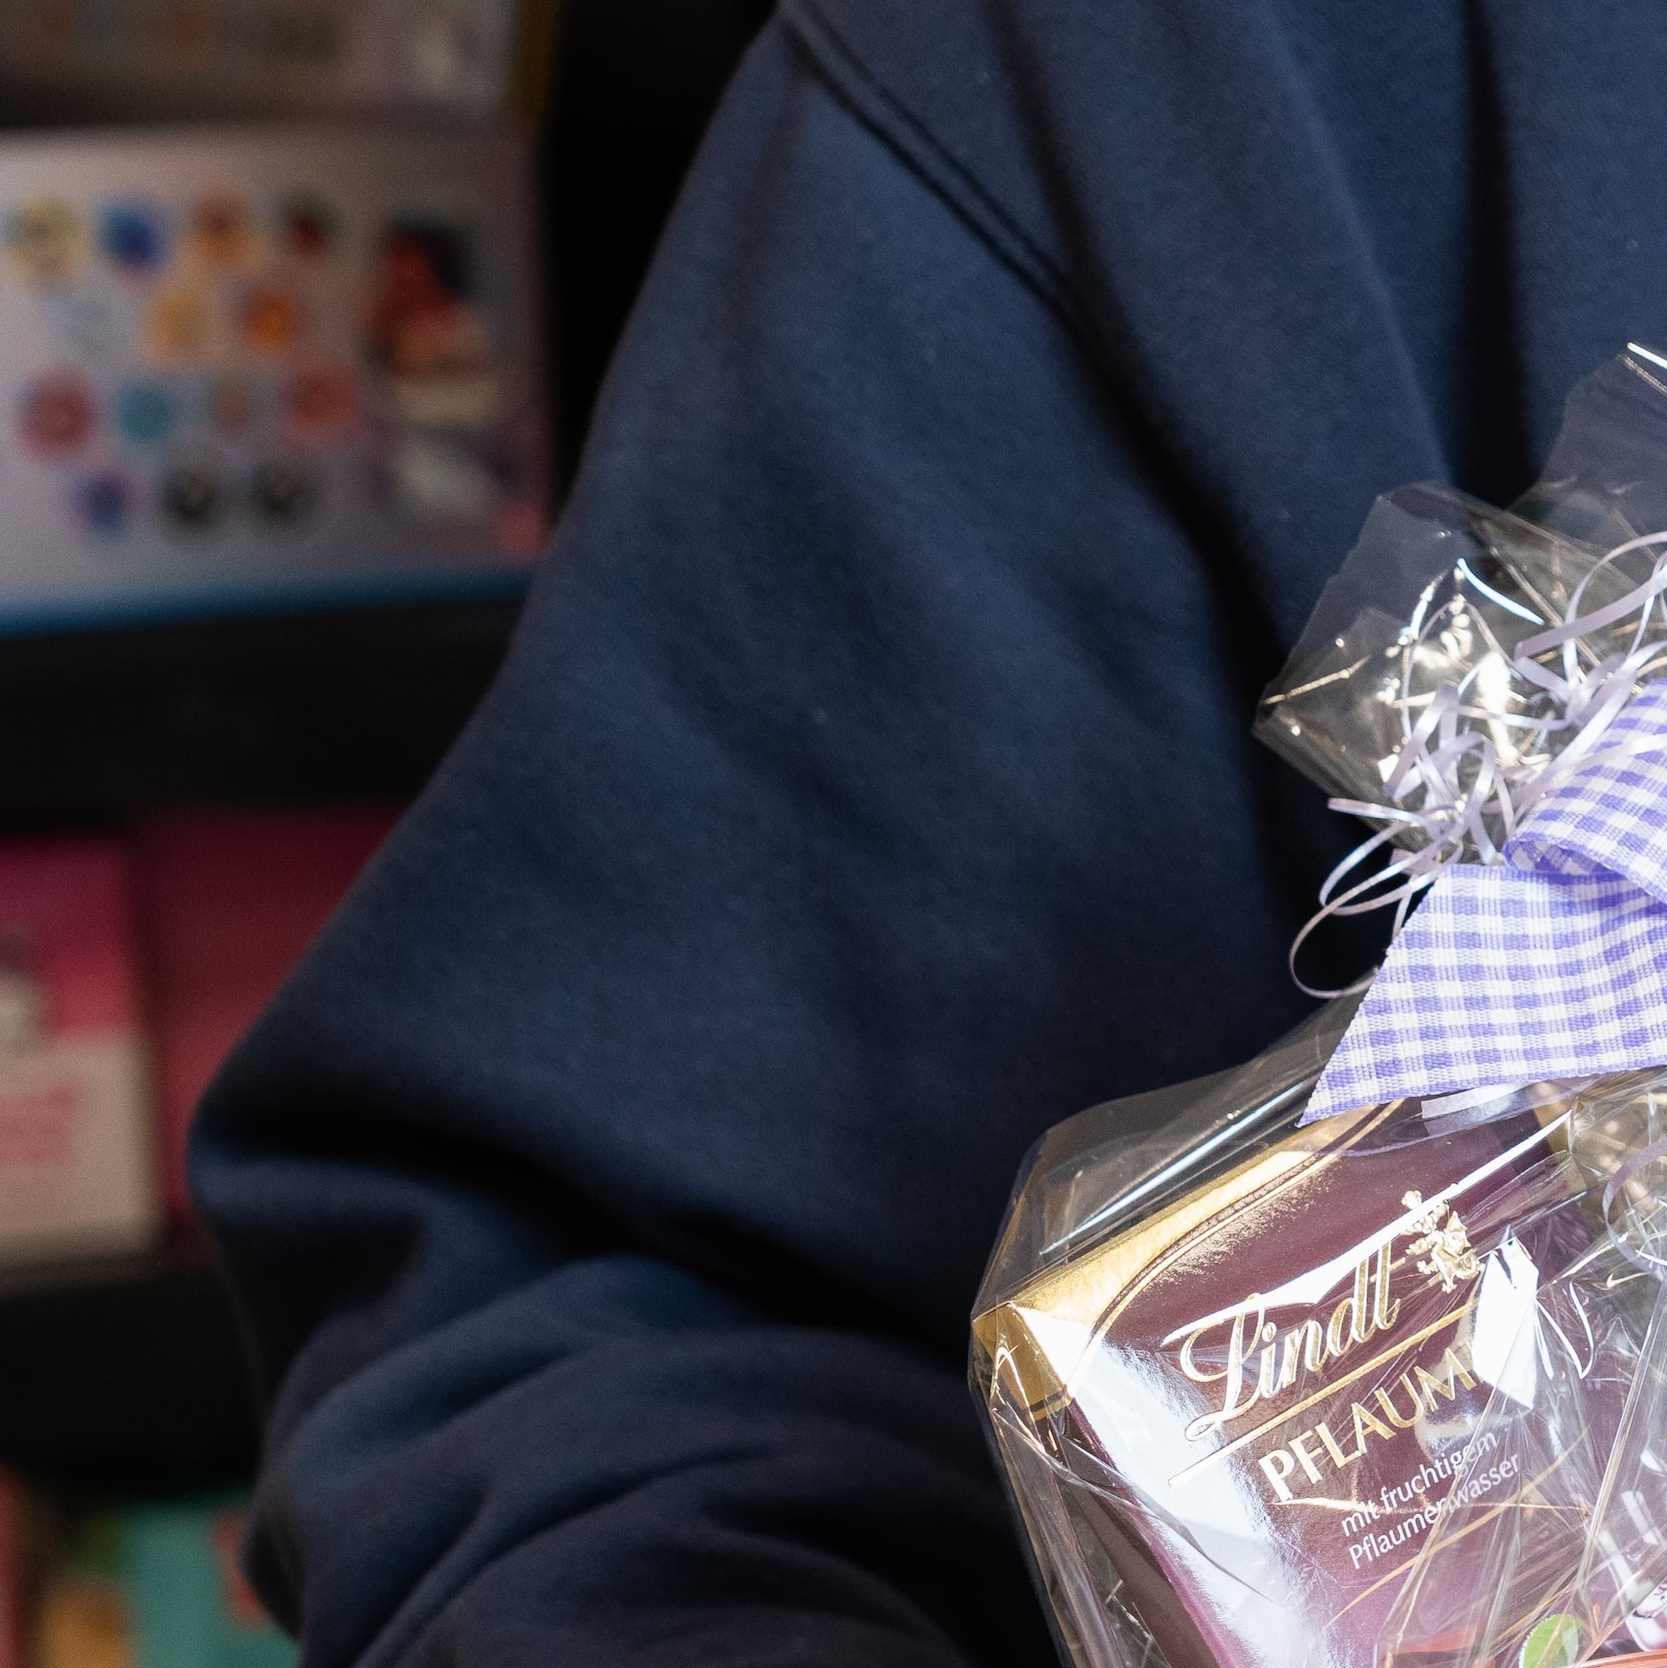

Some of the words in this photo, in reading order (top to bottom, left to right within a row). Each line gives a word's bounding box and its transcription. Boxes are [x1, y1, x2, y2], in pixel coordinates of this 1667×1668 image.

[1180, 1240, 1400, 1442] Lindt
[1258, 1340, 1484, 1502] PFLAUM
[1341, 1500, 1381, 1537] mit
[1379, 1431, 1499, 1510] fruchtigem
[1348, 1453, 1520, 1570] Pflaumenwasser
